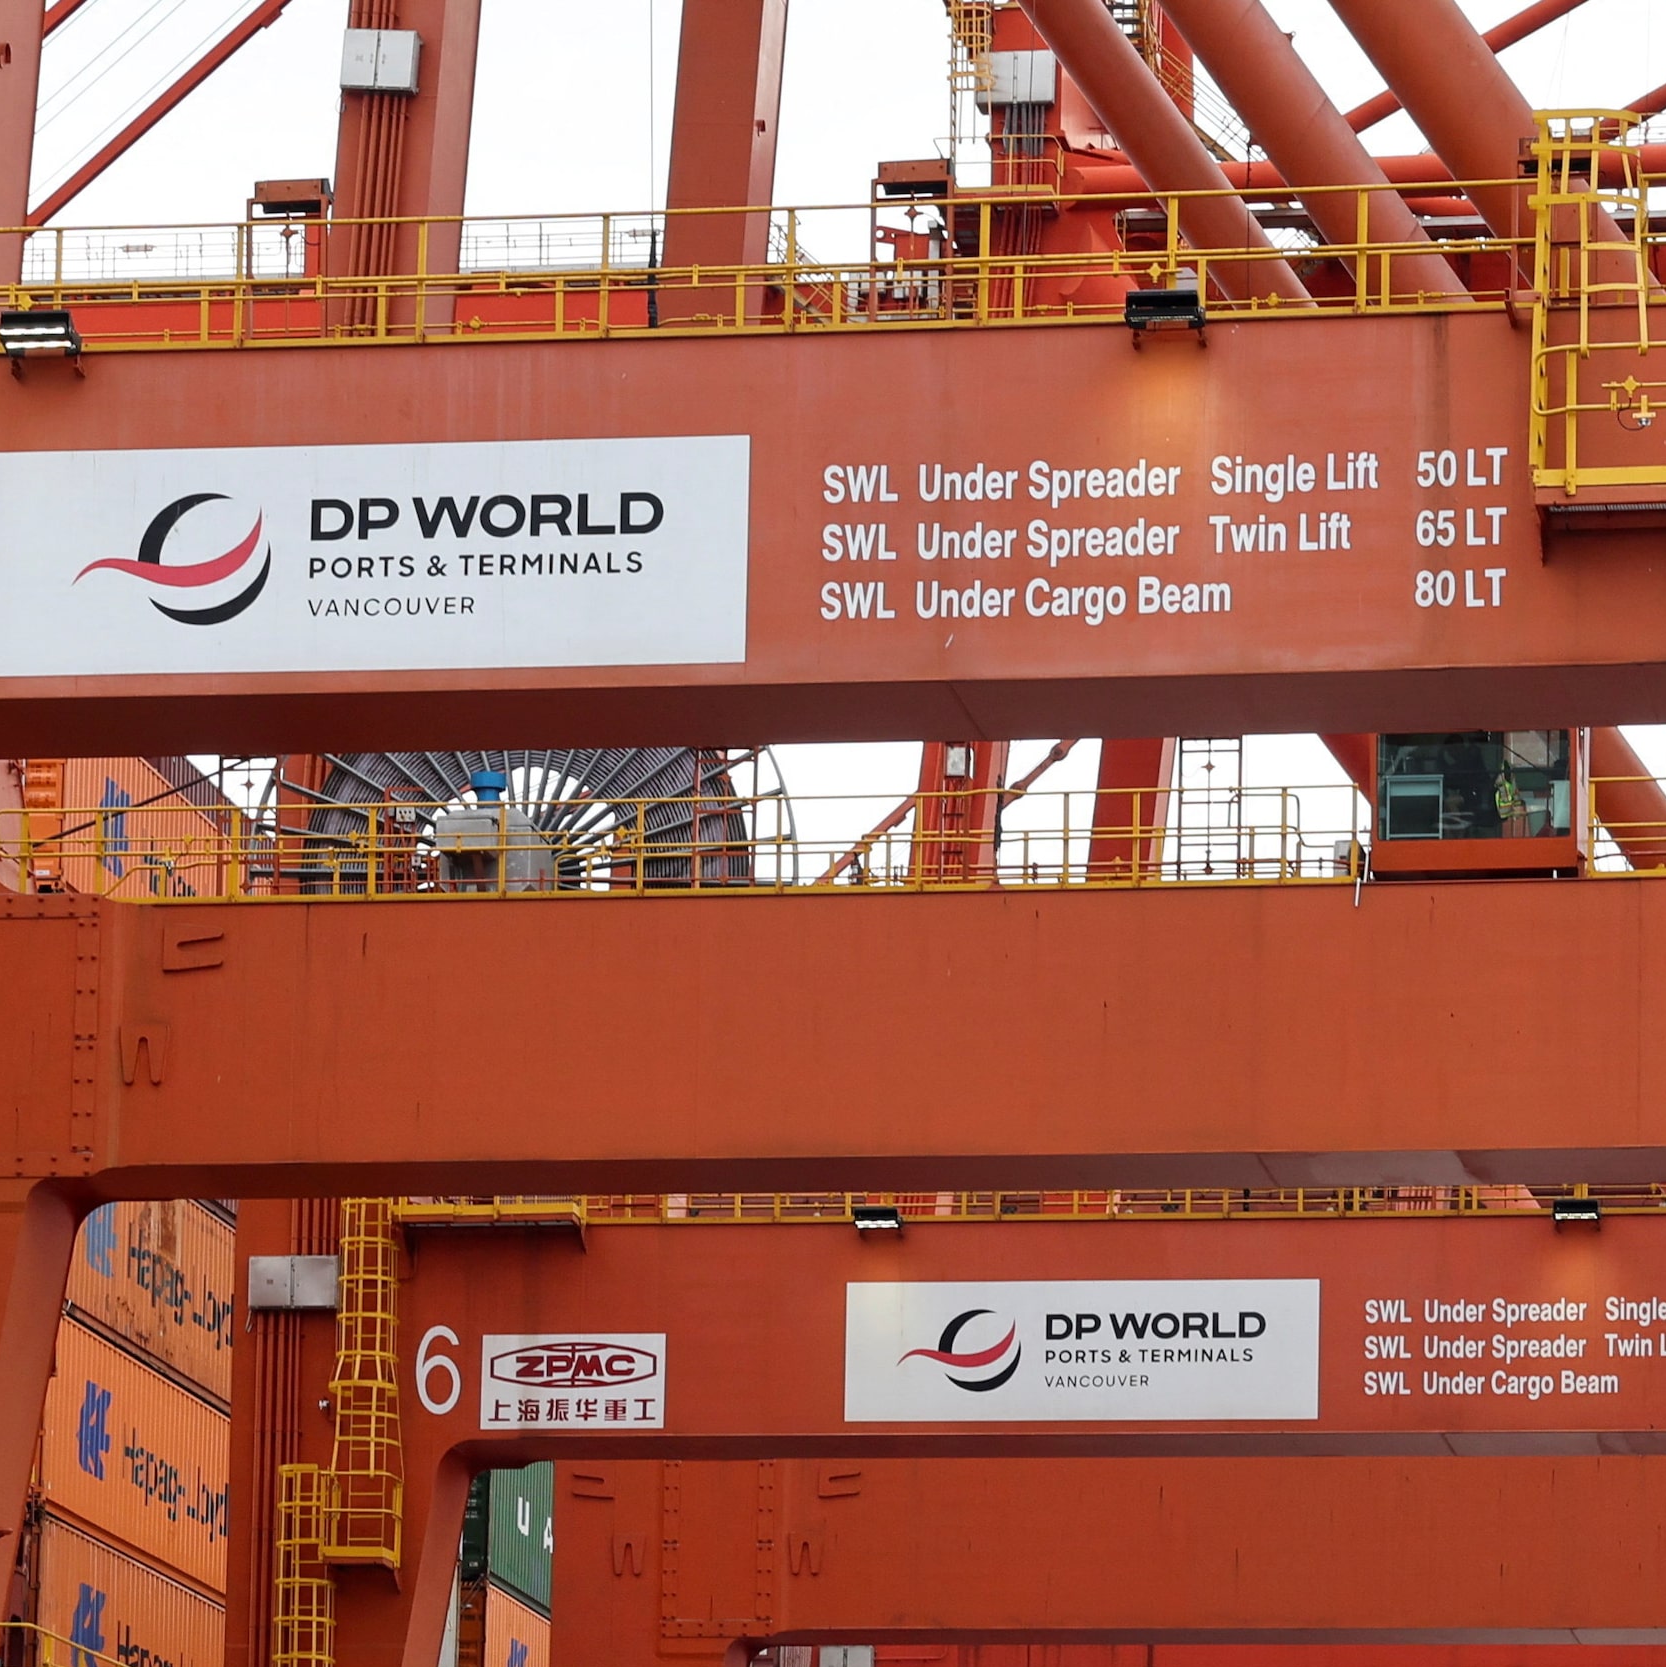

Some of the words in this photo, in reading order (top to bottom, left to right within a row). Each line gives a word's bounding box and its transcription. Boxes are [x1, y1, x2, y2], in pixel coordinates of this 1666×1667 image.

[823, 465, 899, 503] SWL
[919, 460, 1018, 502] Under
[1029, 458, 1181, 508] Spreader
[1211, 455, 1316, 502] Single
[1328, 451, 1379, 490] Lift
[1417, 450, 1457, 487] 50
[1466, 447, 1509, 486] LT
[310, 498, 400, 541] DP
[412, 492, 664, 539] WORLD
[822, 523, 896, 562] SWL
[917, 518, 1017, 559] Under
[1027, 517, 1180, 567] Spreader
[1209, 514, 1287, 554] Twin
[1299, 511, 1351, 551] Lift
[1415, 510, 1455, 548] 65
[1466, 507, 1508, 546] LT
[309, 556, 415, 579] PORTS
[427, 555, 447, 577] &
[459, 551, 643, 576] TERMINALS
[308, 596, 475, 617] VANCOUVER
[820, 581, 895, 620] SWL
[916, 578, 1016, 619] Under
[1025, 577, 1127, 626] Cargo
[1138, 575, 1231, 614] Beam
[1415, 570, 1455, 608] 80
[1465, 568, 1507, 607] LT
[1045, 1313, 1101, 1340] DP
[1111, 1312, 1266, 1339] WORLD
[1365, 1299, 1412, 1323] SWL
[1424, 1297, 1486, 1322] Under
[1492, 1297, 1587, 1327] Spreader
[1045, 1349, 1112, 1364] PORTS
[1118, 1349, 1132, 1363] &
[1138, 1347, 1254, 1363] TERMINALS
[1364, 1336, 1412, 1360] SWL
[1423, 1334, 1486, 1359] Under
[1492, 1333, 1587, 1364] Spreader
[1605, 1333, 1653, 1358] Twin
[416, 1325, 461, 1415] 6
[516, 1355, 636, 1378] ZPMC
[1044, 1375, 1150, 1388] VANCOUVER
[1364, 1373, 1411, 1396] SWL
[1423, 1371, 1486, 1396] Under
[1491, 1370, 1555, 1400] Cargo
[1560, 1370, 1619, 1394] Beam
[488, 1398, 656, 1422] 上海振华重工
